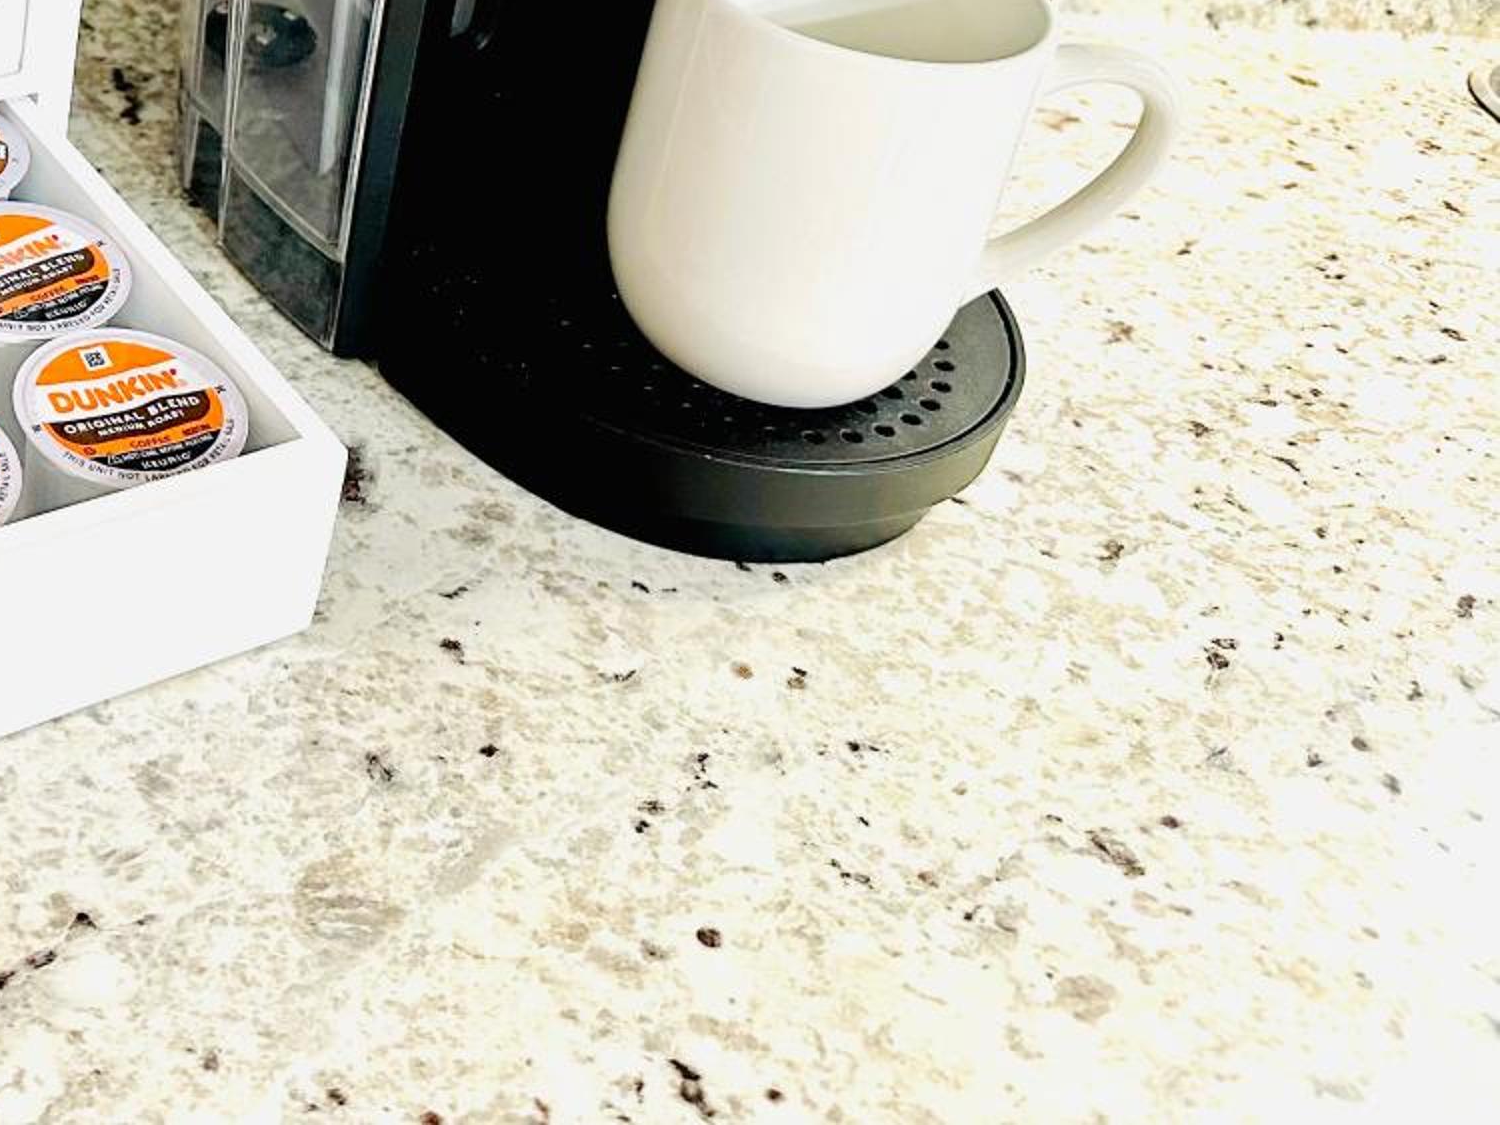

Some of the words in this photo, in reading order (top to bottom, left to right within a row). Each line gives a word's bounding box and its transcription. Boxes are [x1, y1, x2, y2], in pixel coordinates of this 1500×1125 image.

[43, 252, 86, 272] BLEND
[47, 368, 177, 413] DUNKIN'
[64, 412, 146, 435] ORIGINAL
[149, 396, 200, 415] BLEND
[129, 436, 171, 449] COFFEE
[141, 452, 191, 470] KEURIG
